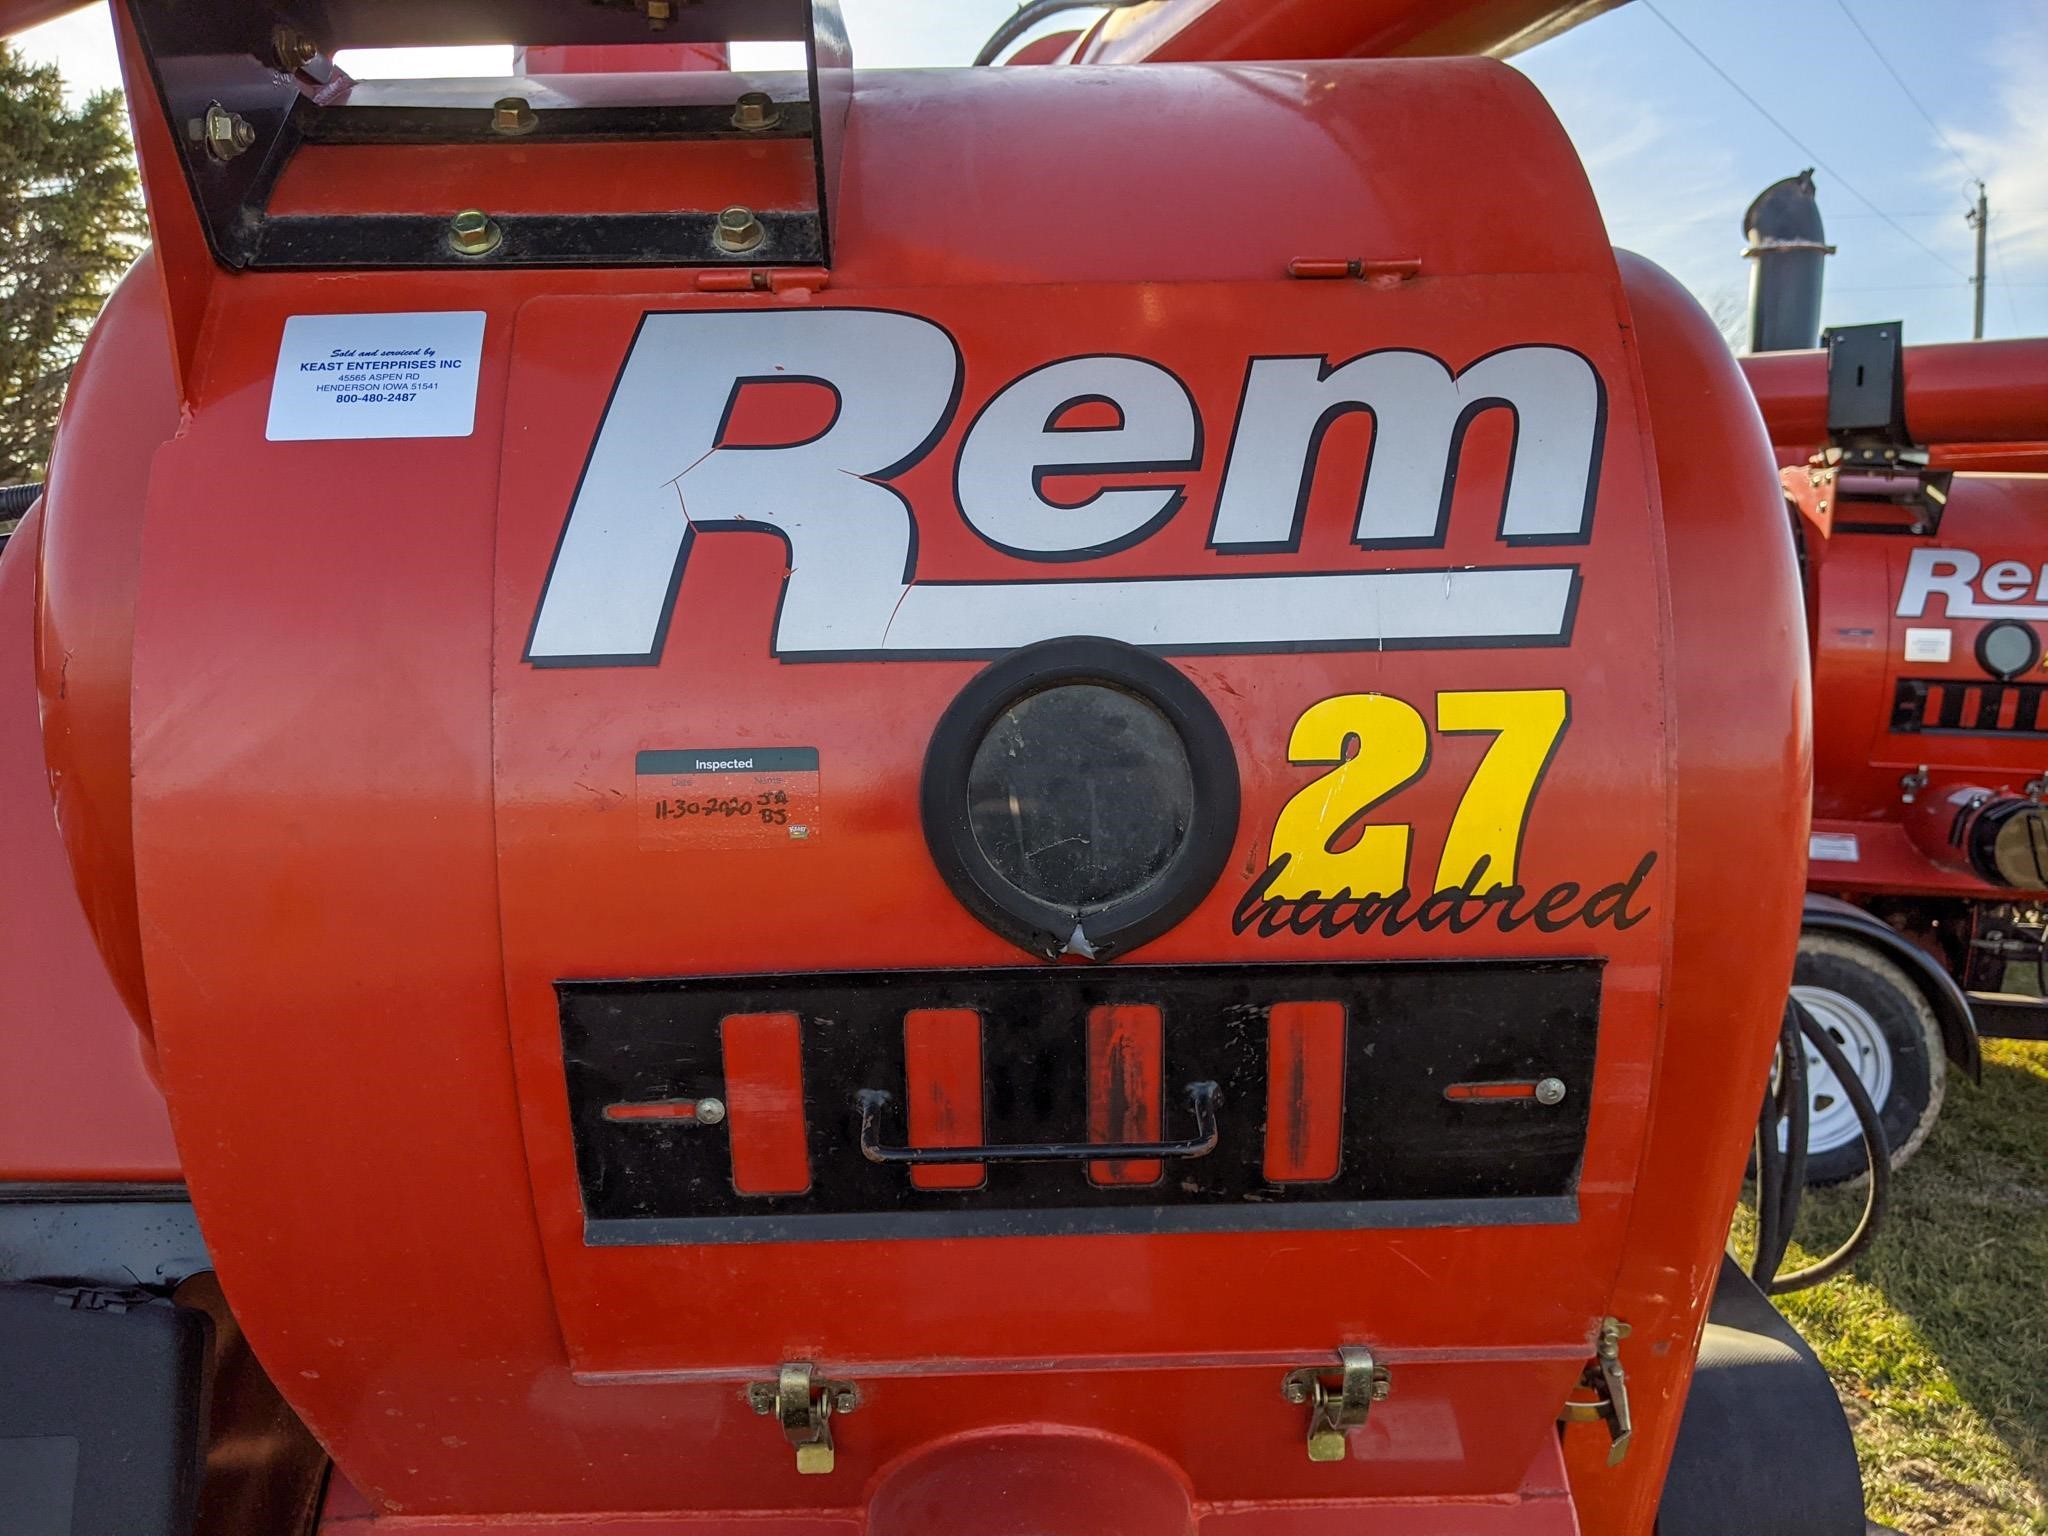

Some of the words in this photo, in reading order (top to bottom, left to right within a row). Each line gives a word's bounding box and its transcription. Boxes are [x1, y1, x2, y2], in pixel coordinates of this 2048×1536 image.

[330, 349, 355, 358] Sold
[357, 349, 378, 358] and
[380, 348, 421, 357] serviced
[423, 346, 436, 357] by
[300, 361, 344, 372] KEAST
[346, 360, 437, 371] ENTERPRISES
[439, 359, 462, 370] INC
[338, 373, 367, 382] 45565
[368, 372, 403, 382] ASPEN
[405, 372, 420, 381] RD
[316, 383, 380, 392] HENDERSON
[382, 382, 409, 391] IOWA
[411, 382, 439, 391] 51541
[336, 392, 417, 403] 800-480-2487
[523, 308, 1606, 665] Rem
[1895, 547, 2048, 619] Re
[695, 758, 754, 772] Inspected
[1263, 688, 1571, 902] 27
[1232, 850, 1658, 938] hundred
